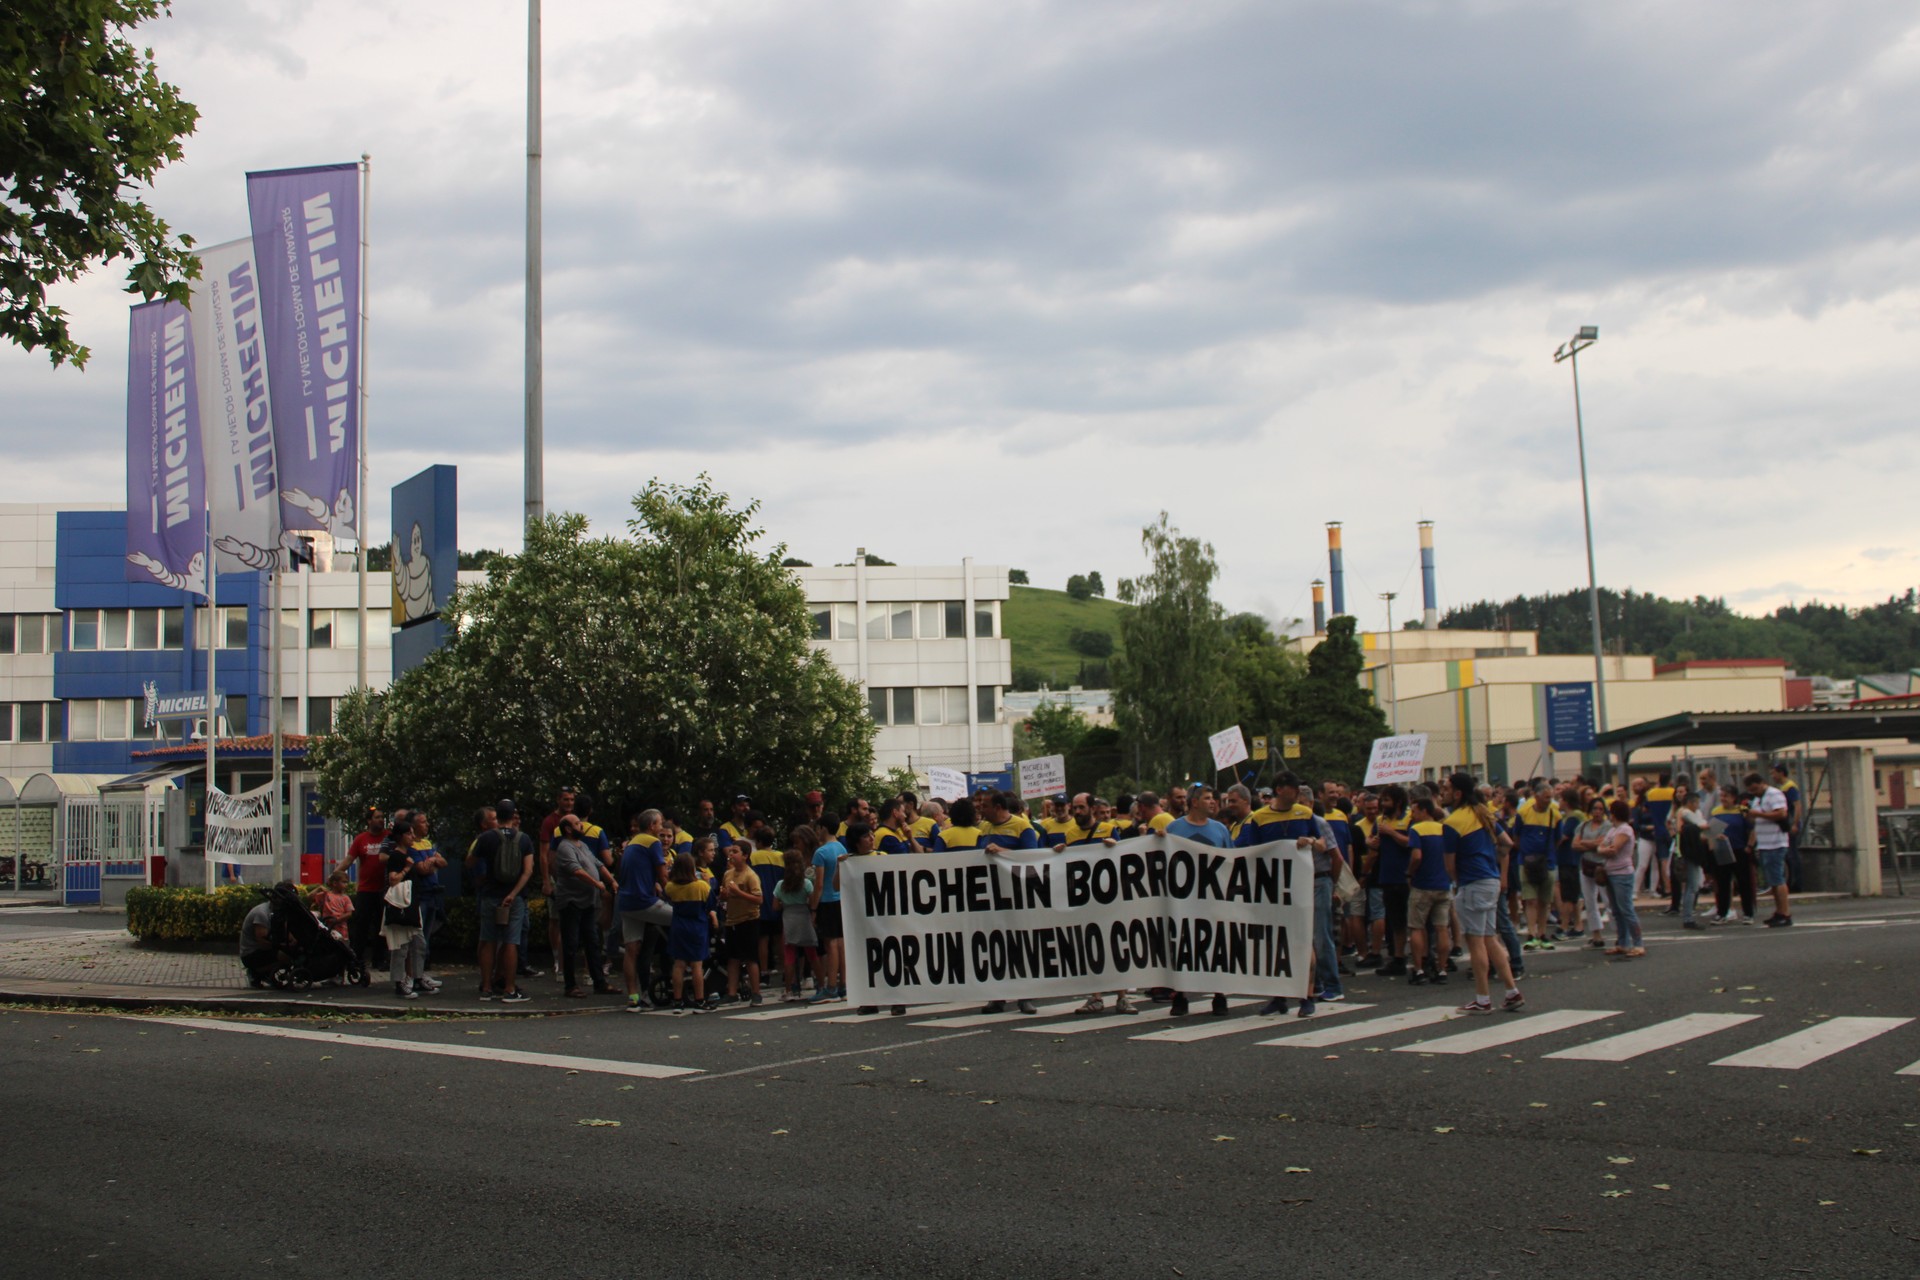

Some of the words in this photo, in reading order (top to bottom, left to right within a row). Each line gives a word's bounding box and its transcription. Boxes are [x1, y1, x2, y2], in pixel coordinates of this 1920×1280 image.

[158, 694, 222, 713] MICHELN
[863, 863, 1052, 917] MICHELIN
[1066, 850, 1293, 908] BORROKAN!
[866, 934, 921, 988] POR
[925, 931, 966, 986] UN
[971, 922, 1106, 983] CONVENIO
[1110, 916, 1167, 973] CON
[1168, 915, 1293, 978] GARANTIA
